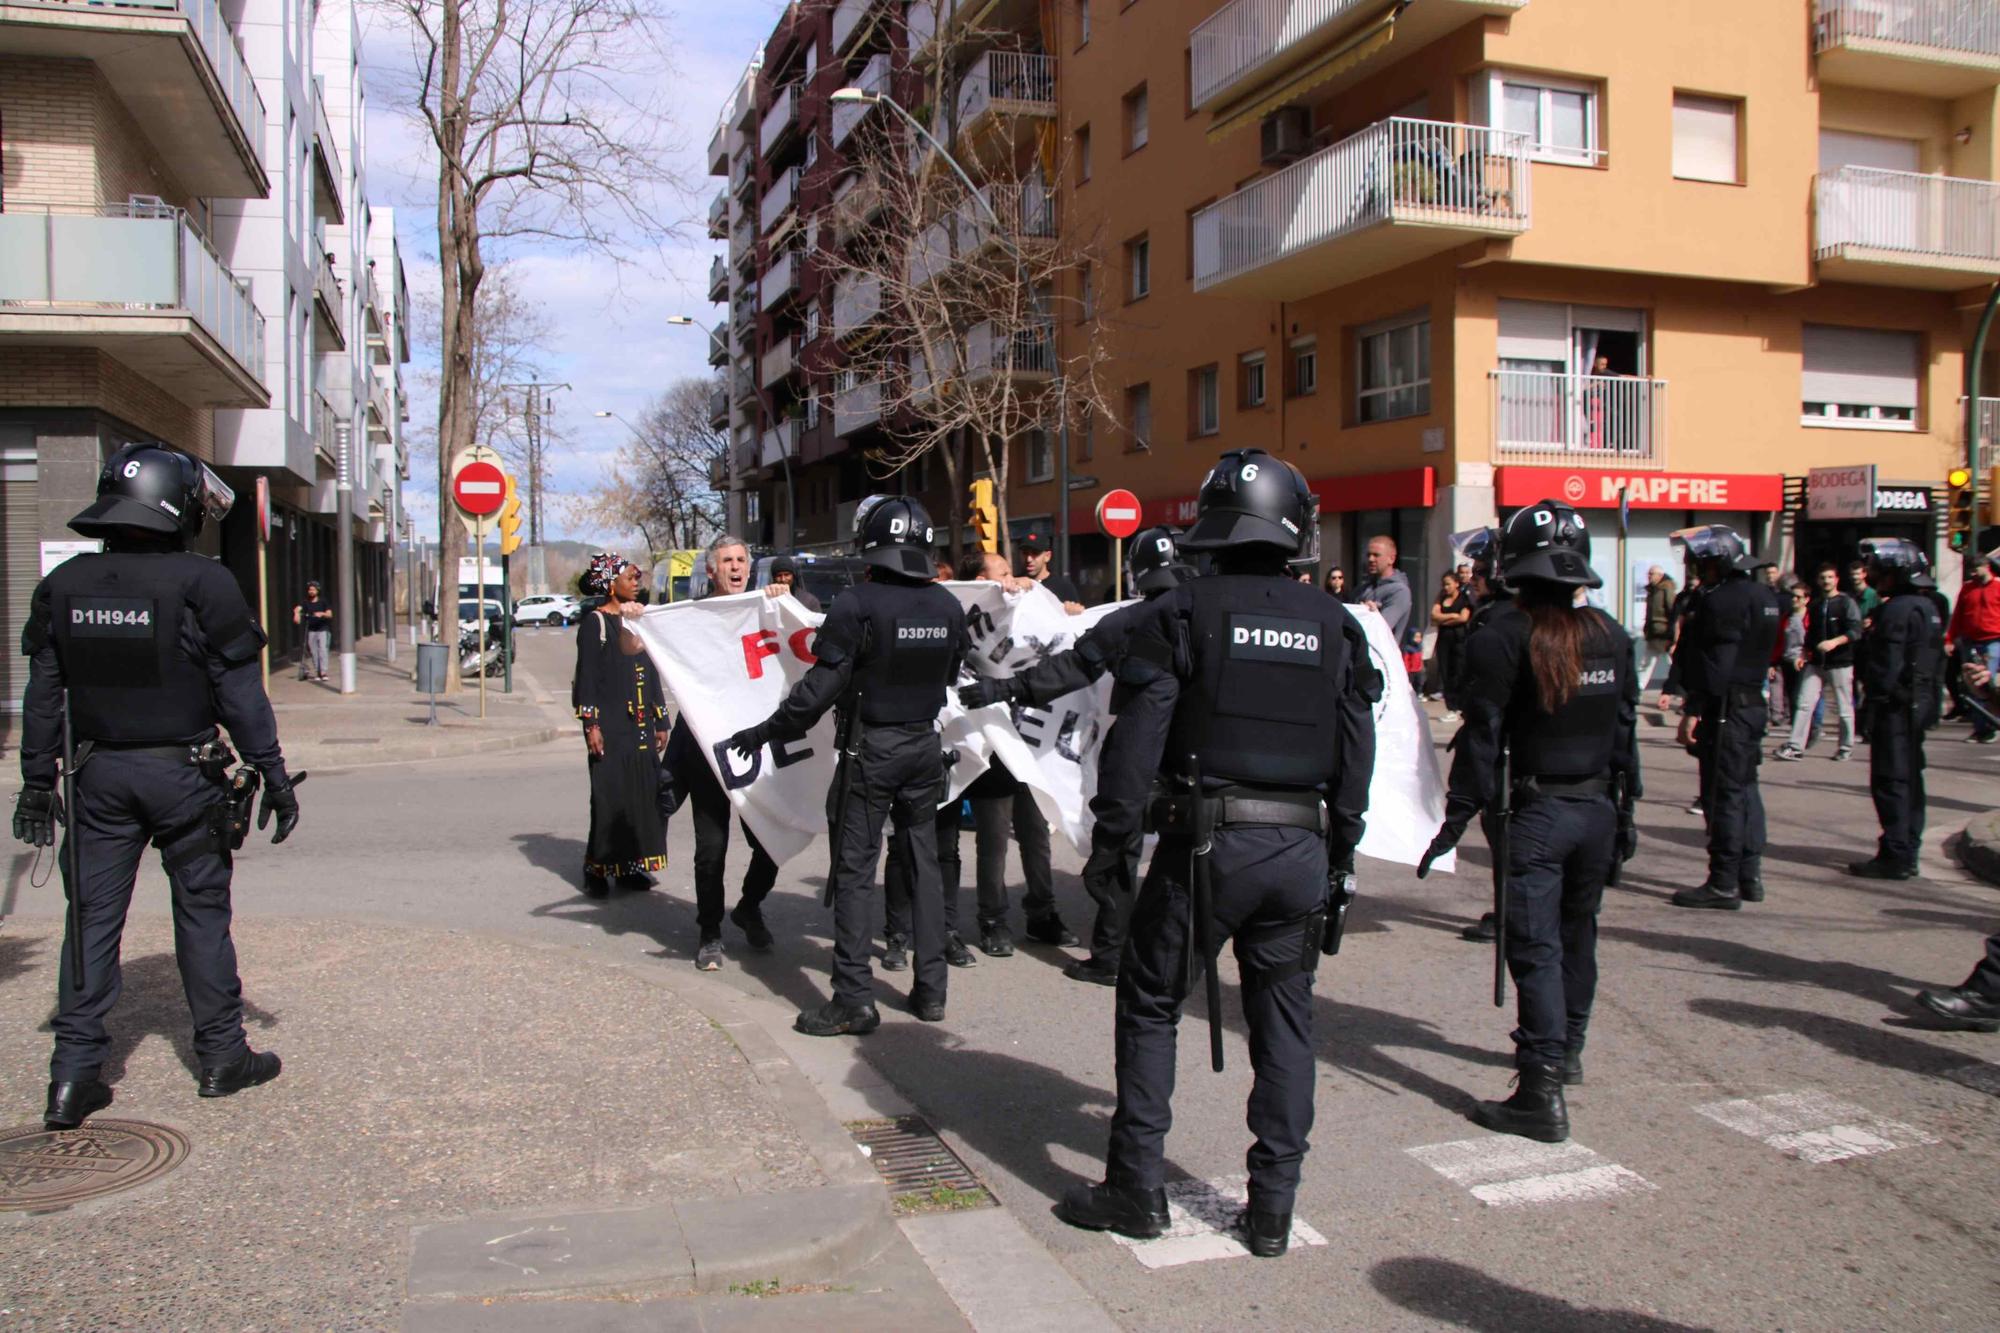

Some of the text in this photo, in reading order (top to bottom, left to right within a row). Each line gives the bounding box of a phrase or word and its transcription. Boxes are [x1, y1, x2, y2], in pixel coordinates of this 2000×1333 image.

[123, 461, 140, 478] 6
[1241, 464, 1259, 482] 6
[1810, 471, 1866, 489] BODEGA
[1601, 476, 1728, 504] MAPFRE
[890, 518, 904, 534] D
[1534, 510, 1553, 527] D
[926, 527, 933, 543] 6
[1156, 538, 1170, 552] D
[72, 609, 150, 625] D1H944
[898, 627, 948, 639] D3D760
[1233, 627, 1319, 651] D1D020
